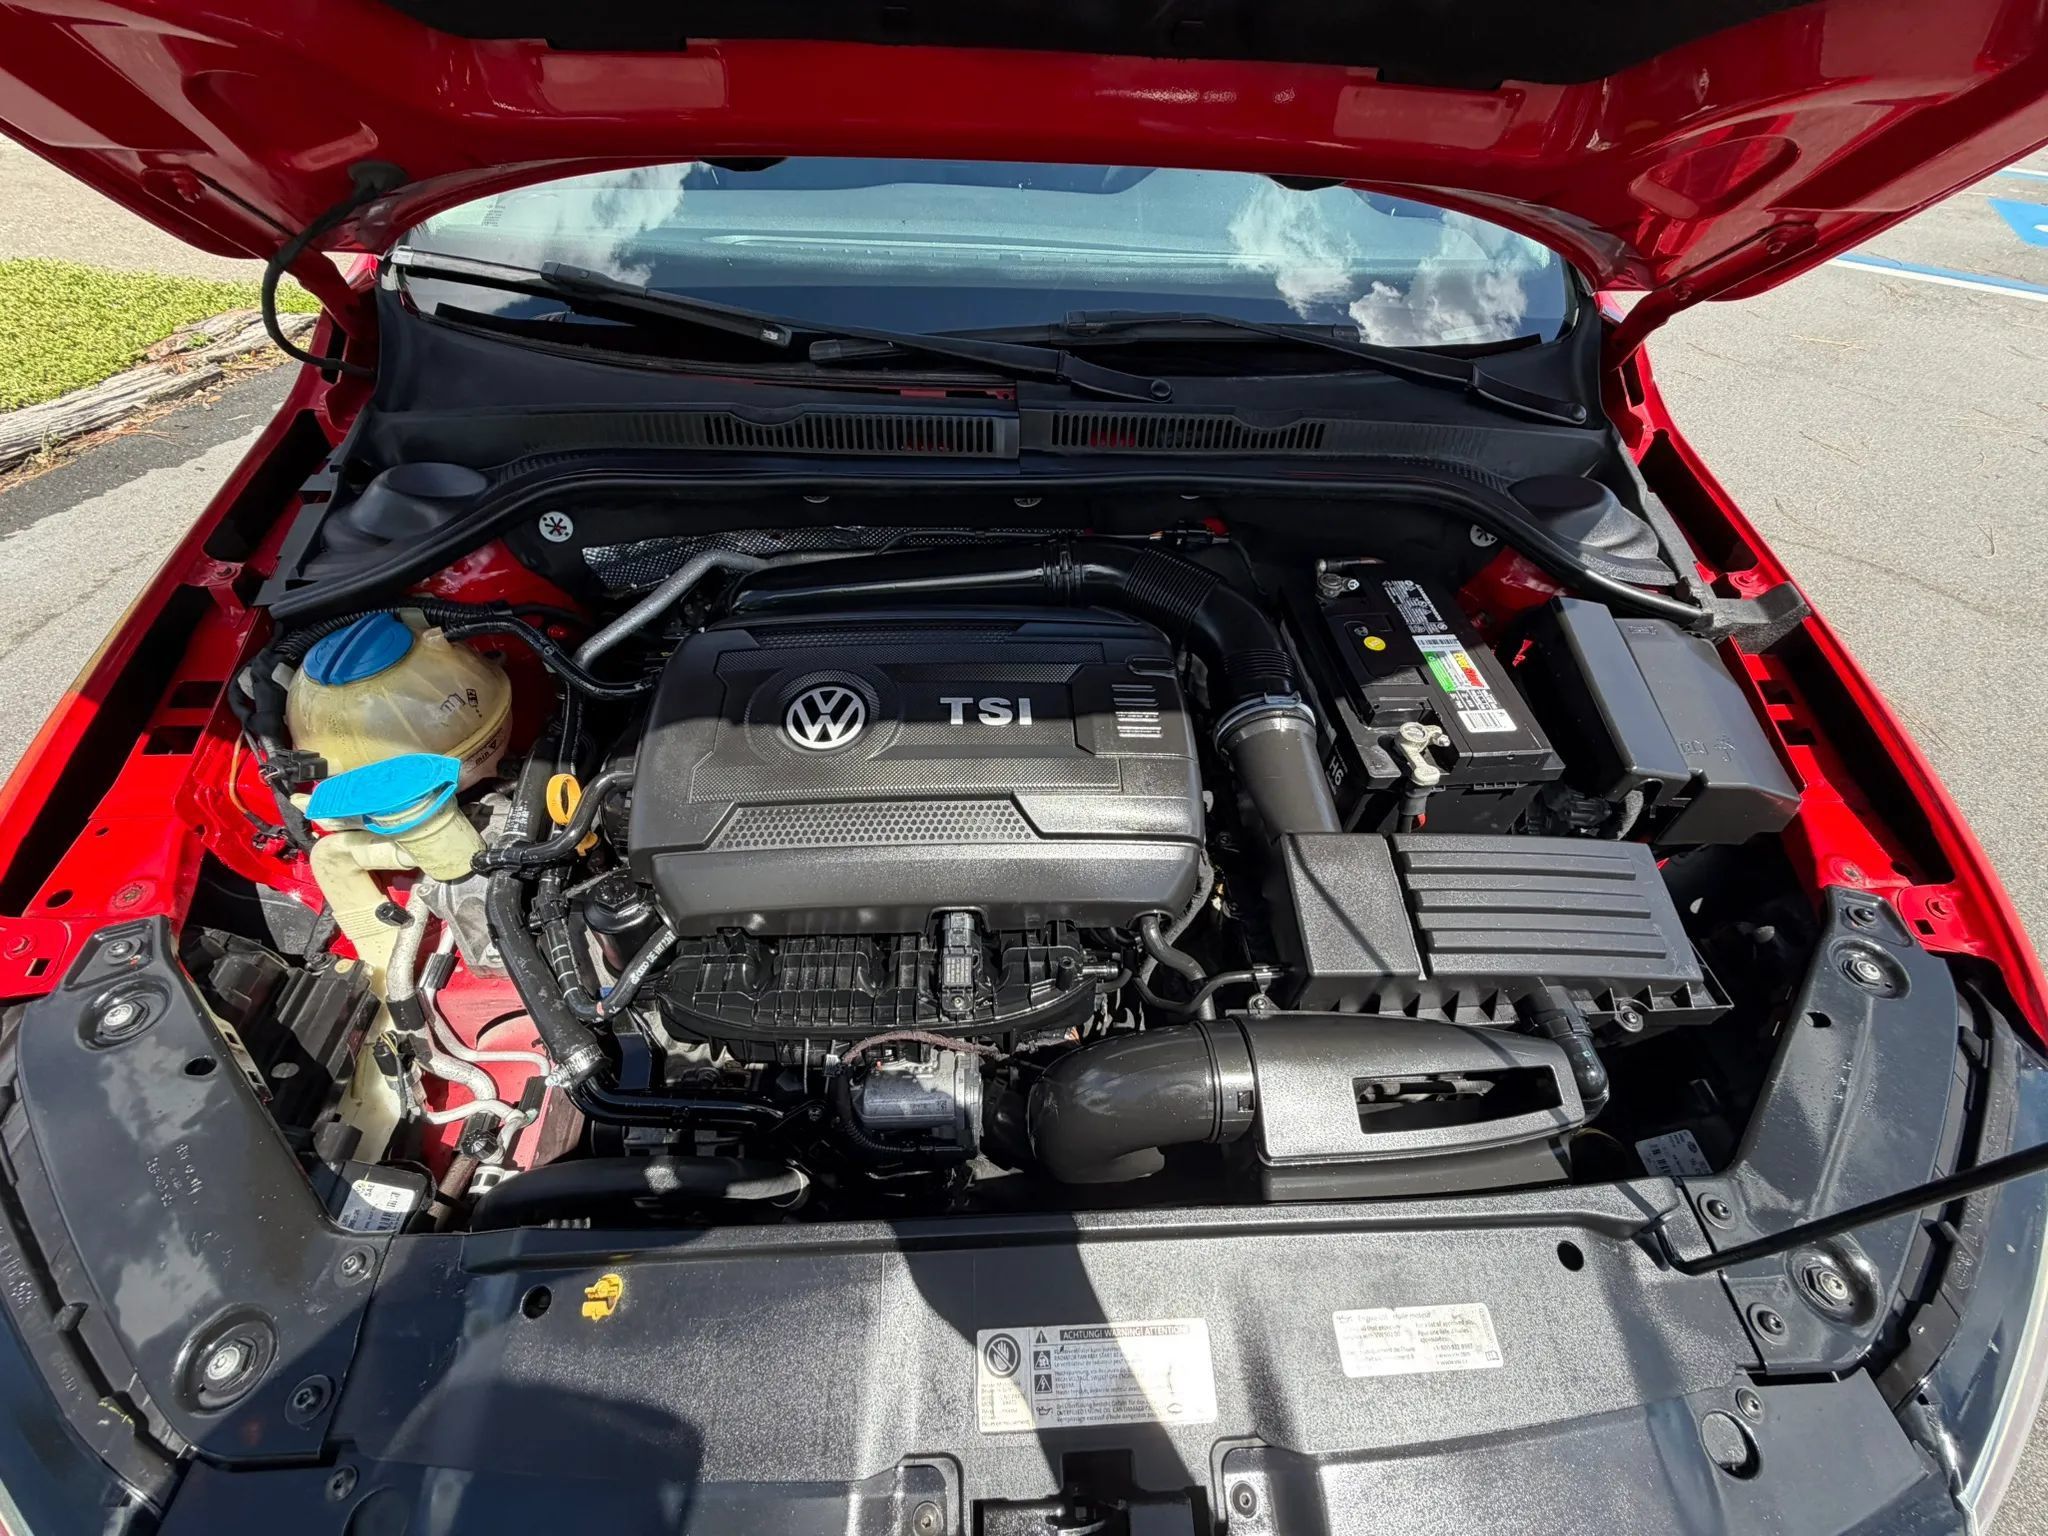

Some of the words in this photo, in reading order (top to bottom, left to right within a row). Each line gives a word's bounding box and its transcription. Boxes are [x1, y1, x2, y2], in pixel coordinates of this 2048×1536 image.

[786, 686, 866, 749] VW
[940, 697, 1033, 726] TSI
[475, 751, 489, 766] min
[1329, 755, 1344, 786] H6
[1063, 1329, 1102, 1340] ACHTUNG!
[1104, 1327, 1143, 1338] WARNING!
